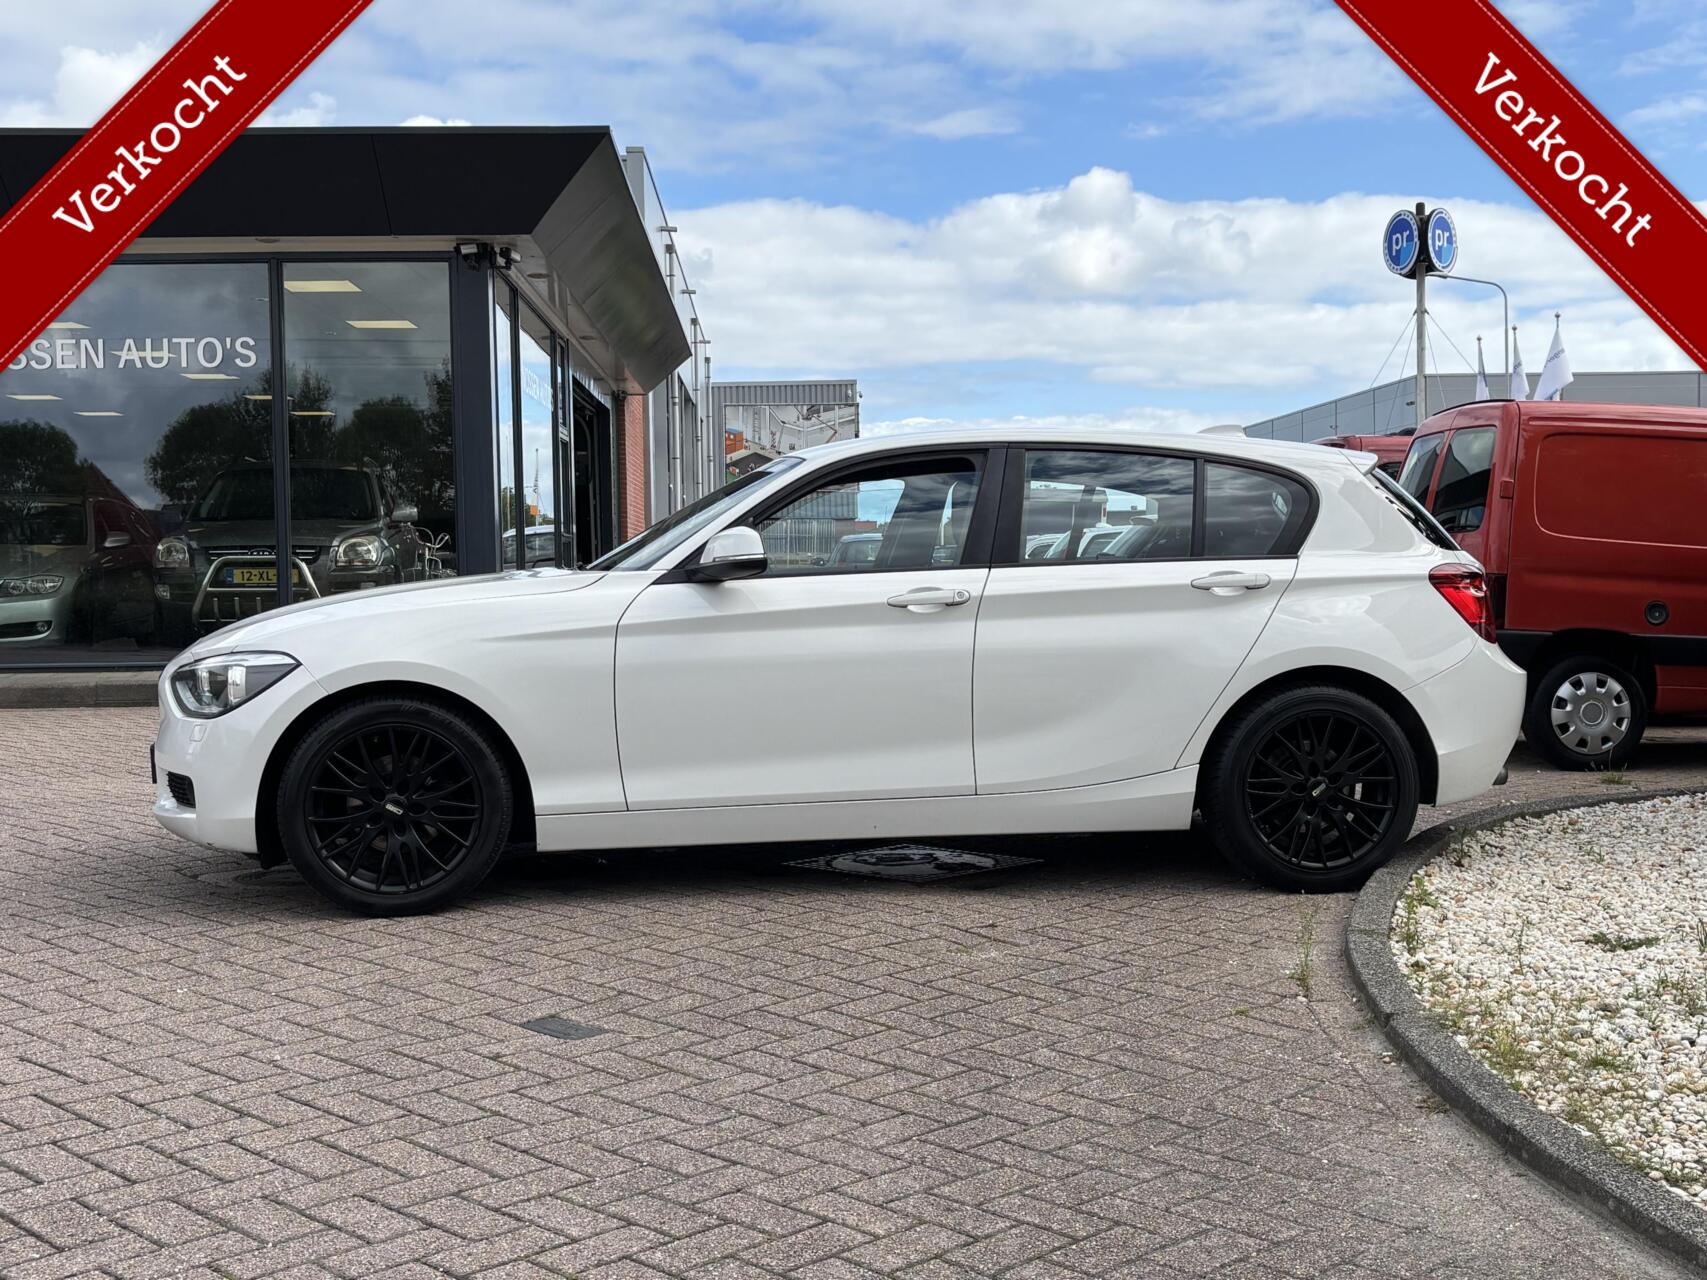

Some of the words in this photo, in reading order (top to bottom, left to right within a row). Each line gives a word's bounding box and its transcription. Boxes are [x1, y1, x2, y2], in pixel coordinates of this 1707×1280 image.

[1392, 230, 1410, 256] pr
[1435, 229, 1450, 250] pr
[118, 337, 257, 369] AUTO'S
[241, 571, 278, 582] 12-XL-
